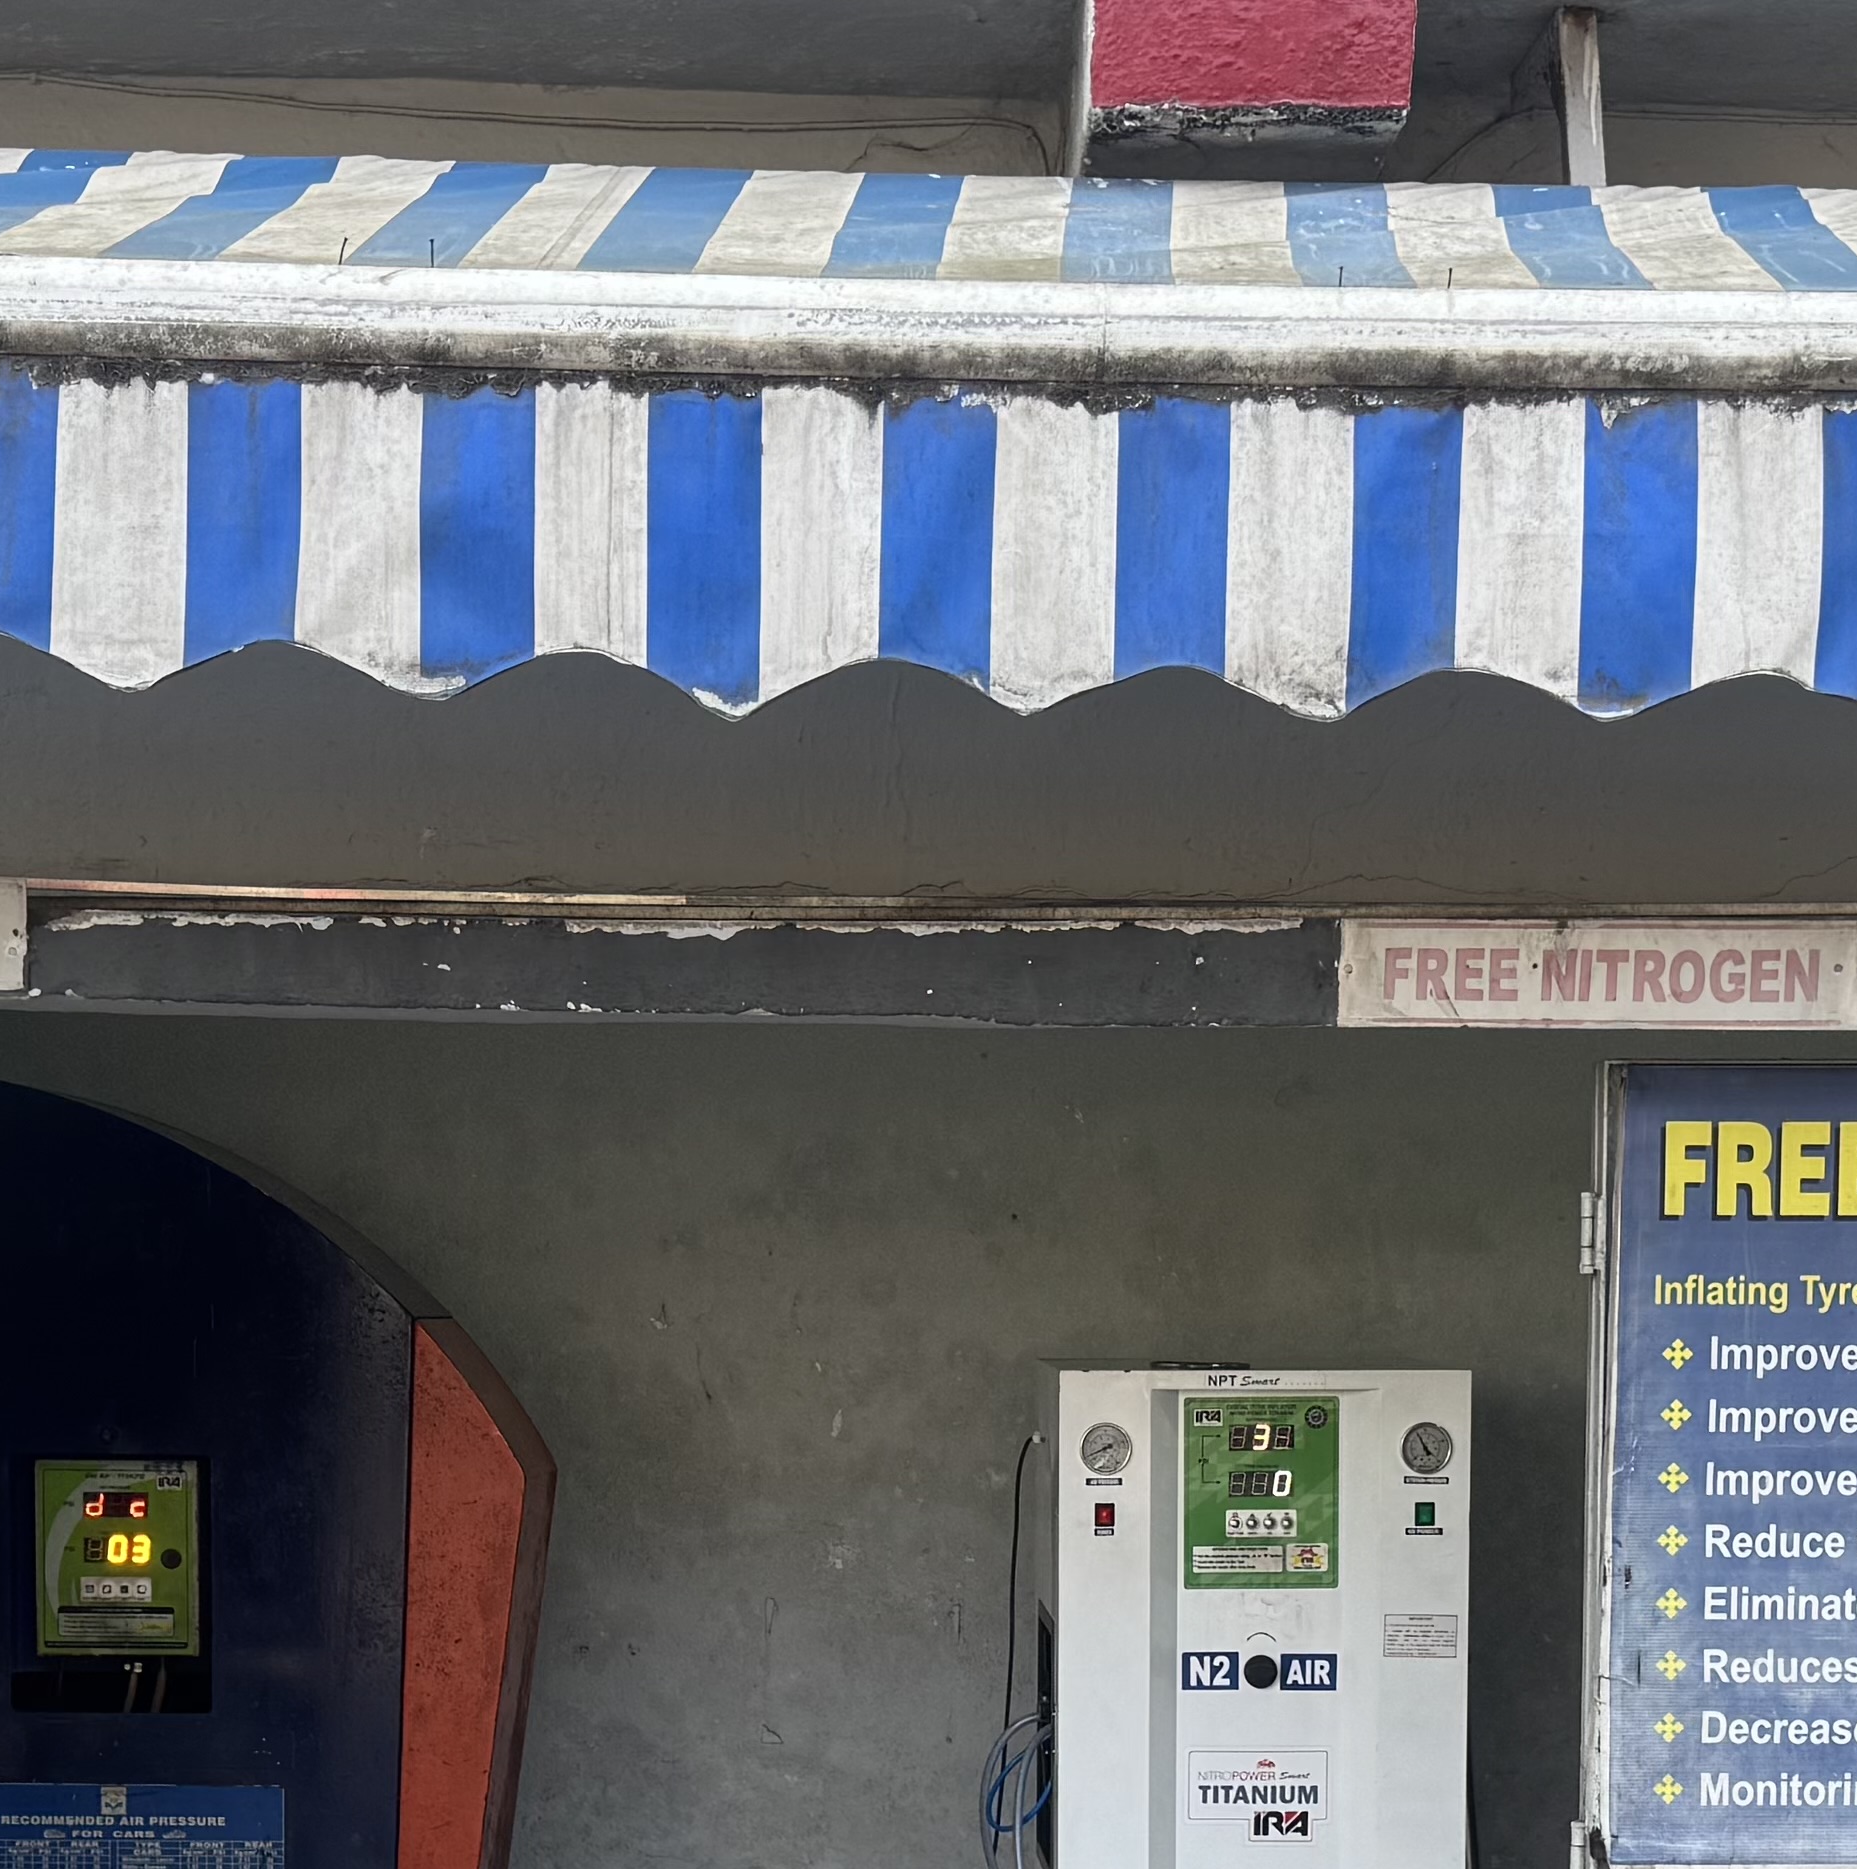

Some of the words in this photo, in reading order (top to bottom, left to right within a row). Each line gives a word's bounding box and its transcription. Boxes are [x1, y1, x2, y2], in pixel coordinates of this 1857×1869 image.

[1383, 946, 1521, 1001] FREE
[1540, 948, 1821, 1004] NITROGEN
[1654, 1274, 1788, 1310] Inflating
[1208, 1374, 1237, 1387] NPT
[1705, 1524, 1845, 1558] Reduce
[1189, 1655, 1231, 1687] N2
[1285, 1659, 1331, 1686] AIR
[1198, 1785, 1319, 1805] TITANIUM
[1, 1815, 115, 1826] RECOMMENDED
[119, 1816, 145, 1826] AIR
[149, 1816, 226, 1826] PRESSURE
[72, 1829, 103, 1838] FOR
[1253, 1810, 1309, 1836] IRA
